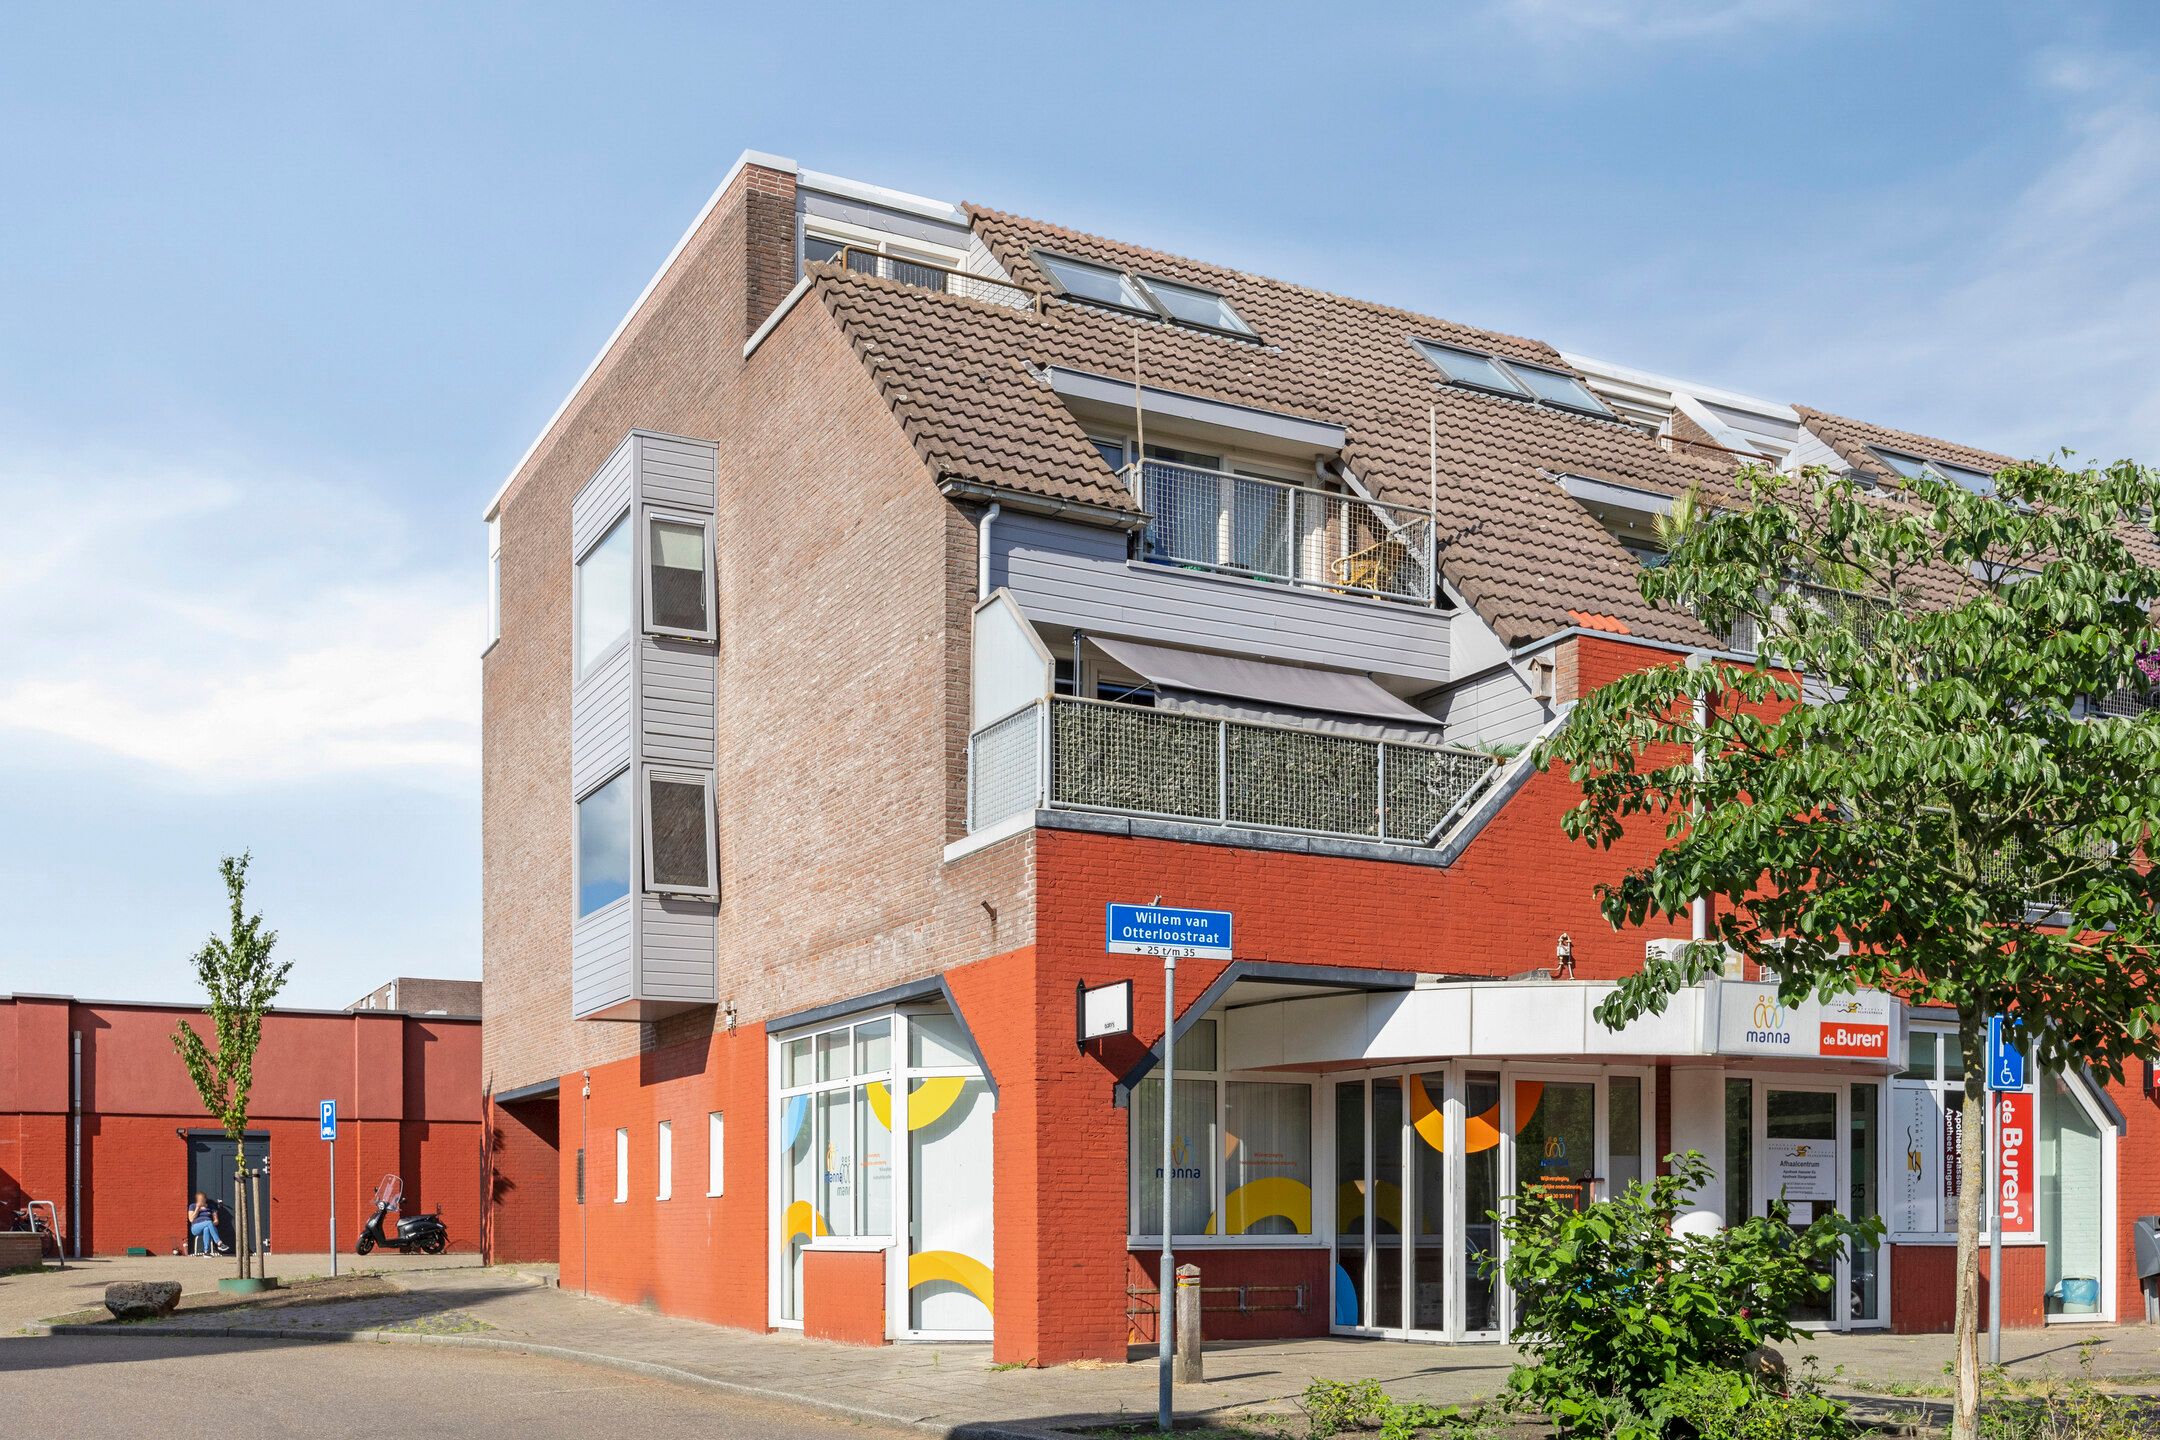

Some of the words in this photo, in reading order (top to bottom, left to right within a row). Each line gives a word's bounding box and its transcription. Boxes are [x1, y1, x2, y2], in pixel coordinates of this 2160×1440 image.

[1136, 912, 1181, 926] Willem
[1186, 917, 1208, 927] van
[1123, 927, 1219, 944] Otterloostraat
[1147, 946, 1159, 955] 25
[1162, 947, 1180, 956] t/m
[1183, 948, 1196, 957] 35
[1746, 1030, 1791, 1044] manna
[1823, 1034, 1835, 1045] de
[1836, 1028, 1881, 1047] Buren
[323, 1104, 332, 1124] P
[2002, 1100, 2015, 1124] de
[1945, 1108, 1954, 1152] Apotheek
[1954, 1110, 1963, 1155] Apotheek
[2002, 1128, 2023, 1219] Buren
[1851, 1184, 1865, 1198] 25
[1945, 1154, 1954, 1214] Slangenbeek
